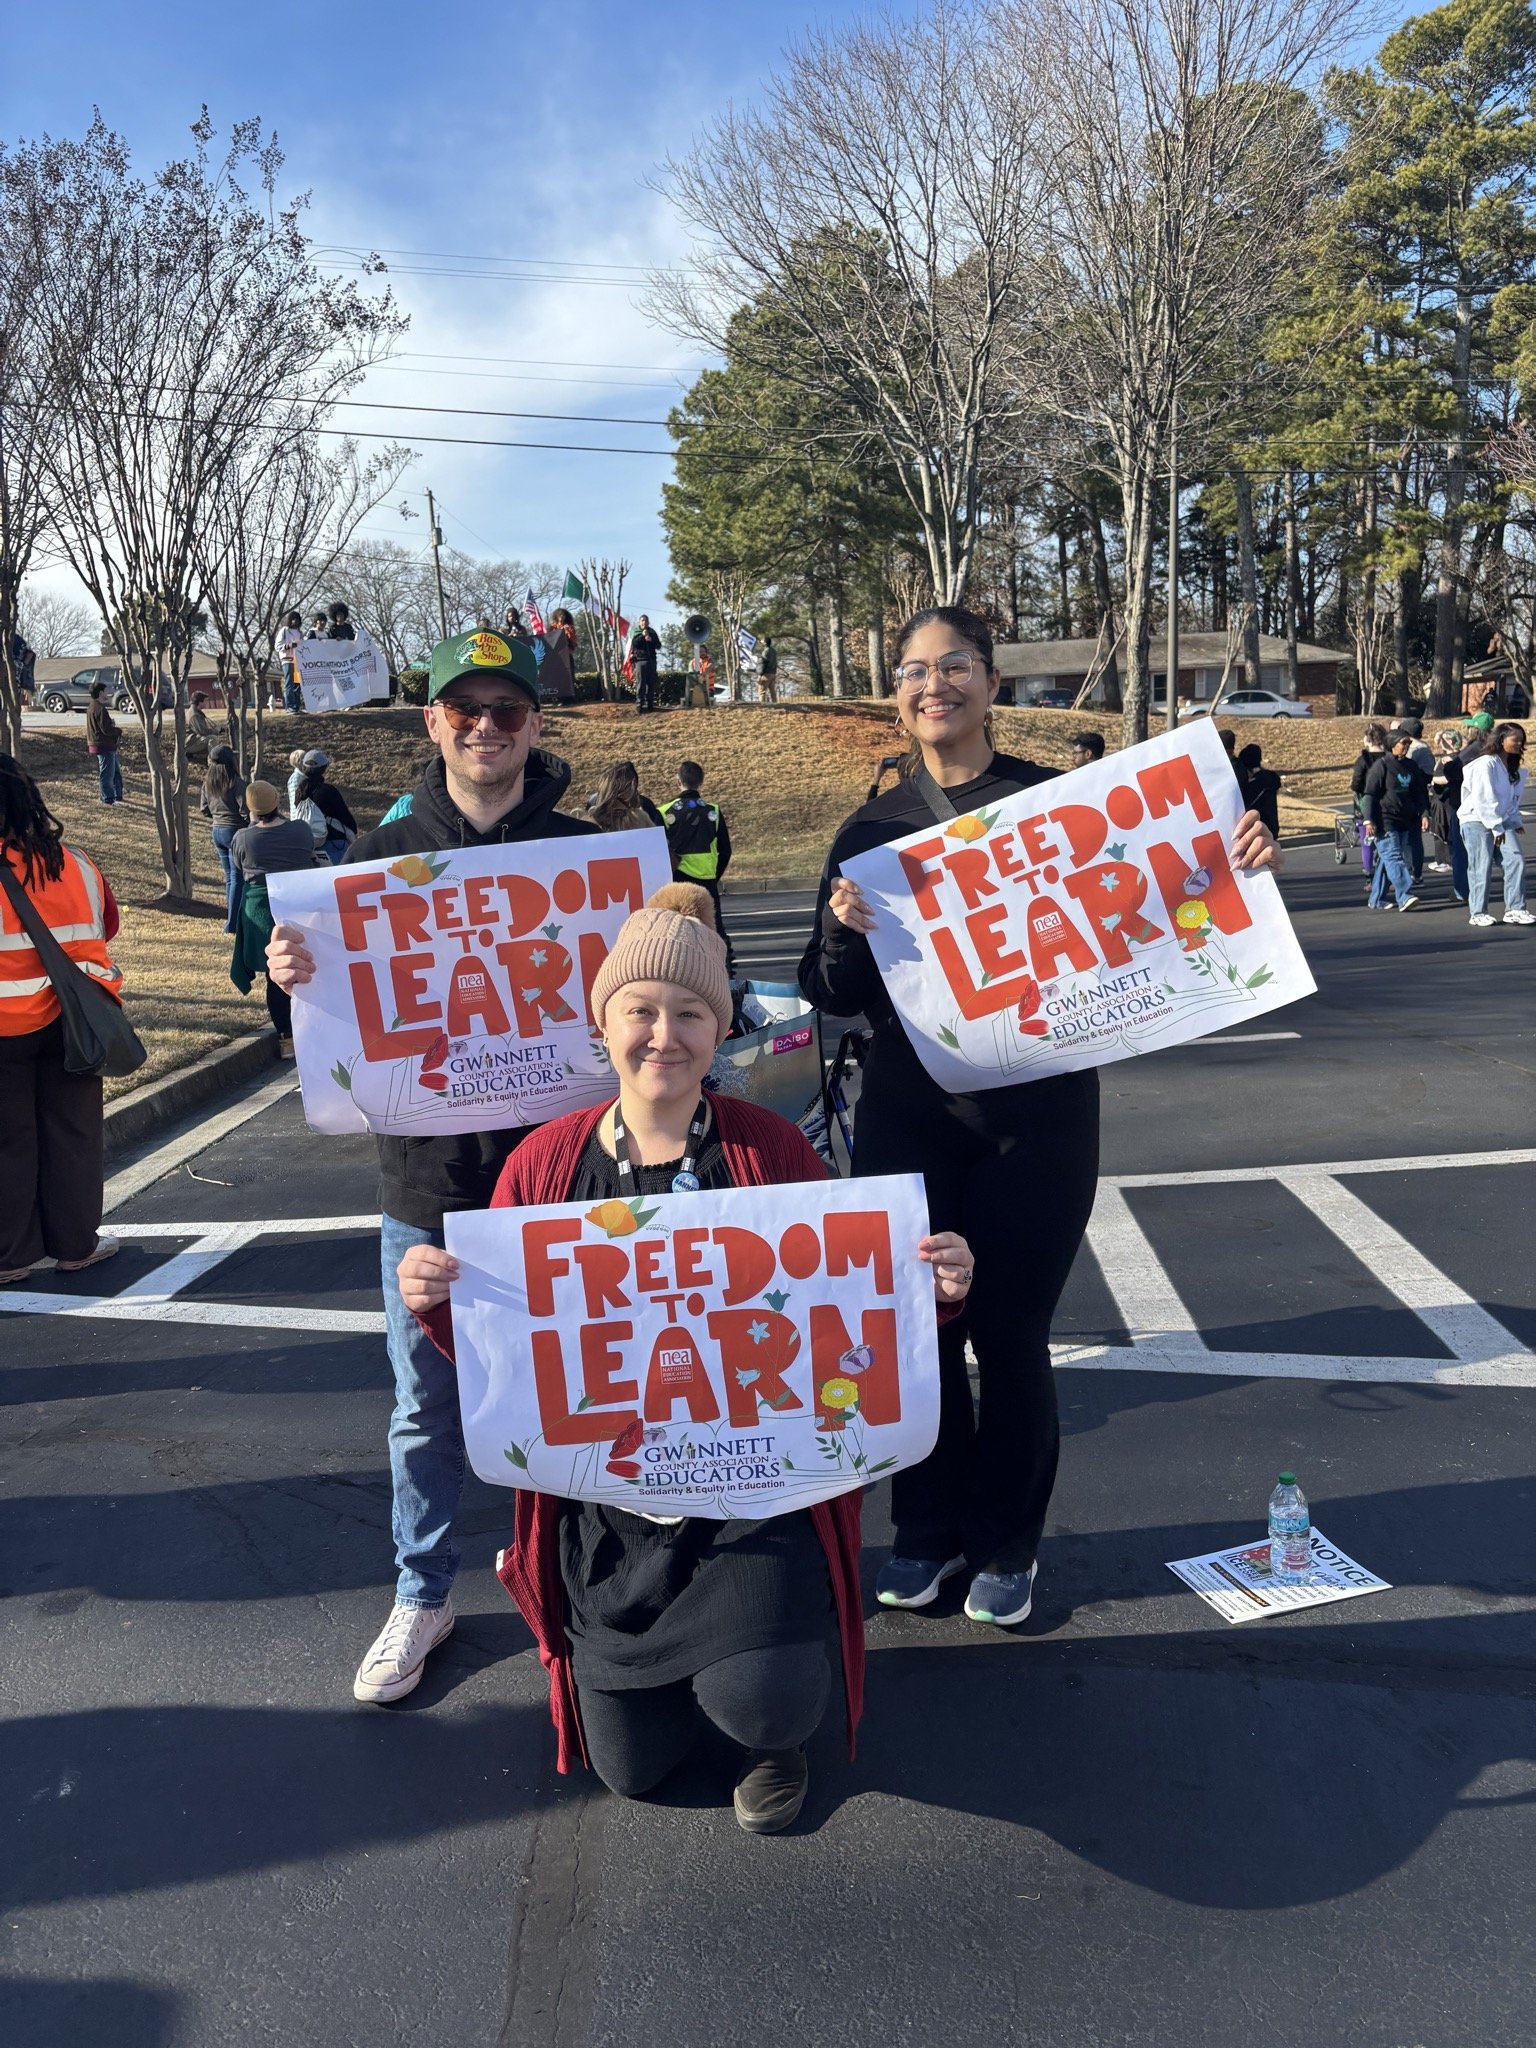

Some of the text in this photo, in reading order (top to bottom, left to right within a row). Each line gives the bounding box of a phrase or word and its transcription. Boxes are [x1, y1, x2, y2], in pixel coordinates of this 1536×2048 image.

[480, 633, 503, 646] Bass
[480, 642, 498, 652] Pro
[481, 650, 509, 664] Shops
[899, 754, 1213, 922] FREEDOM
[1014, 864, 1060, 896] TO
[334, 857, 645, 953] FREEDOM
[930, 831, 1254, 1022] LEARN
[1036, 914, 1060, 931] nea
[448, 929, 494, 953] TO
[460, 974, 483, 987] nea
[1052, 989, 1166, 1040] EDUCATORS
[1057, 1006, 1093, 1024] COUNTY
[1097, 985, 1152, 1011] ASSOCIATION
[777, 1033, 809, 1047] DAISO
[1053, 1034, 1089, 1050] Solidarity
[1098, 1023, 1123, 1037] Equity
[1125, 1020, 1133, 1028] in
[1134, 1005, 1174, 1026] Education
[451, 1067, 563, 1098] EDUCATORS
[459, 1070, 496, 1082] COUNTY
[499, 1061, 553, 1076] ASSOCIATION
[447, 1096, 485, 1109] Solidarity
[494, 1091, 519, 1102] Equity
[520, 1089, 528, 1097] in
[529, 1083, 568, 1096] Education
[522, 1210, 894, 1319] FREEDOM
[651, 1292, 705, 1323] TO
[662, 1350, 690, 1365] nea
[531, 1304, 902, 1446] LEARN
[645, 1462, 781, 1487] EDUCATORS
[653, 1461, 698, 1472] COUNTY
[702, 1456, 769, 1468] ASSOCIATION
[638, 1480, 785, 1496] Solidarity & Equity in Education
[1310, 1537, 1376, 1587] NOTICE
